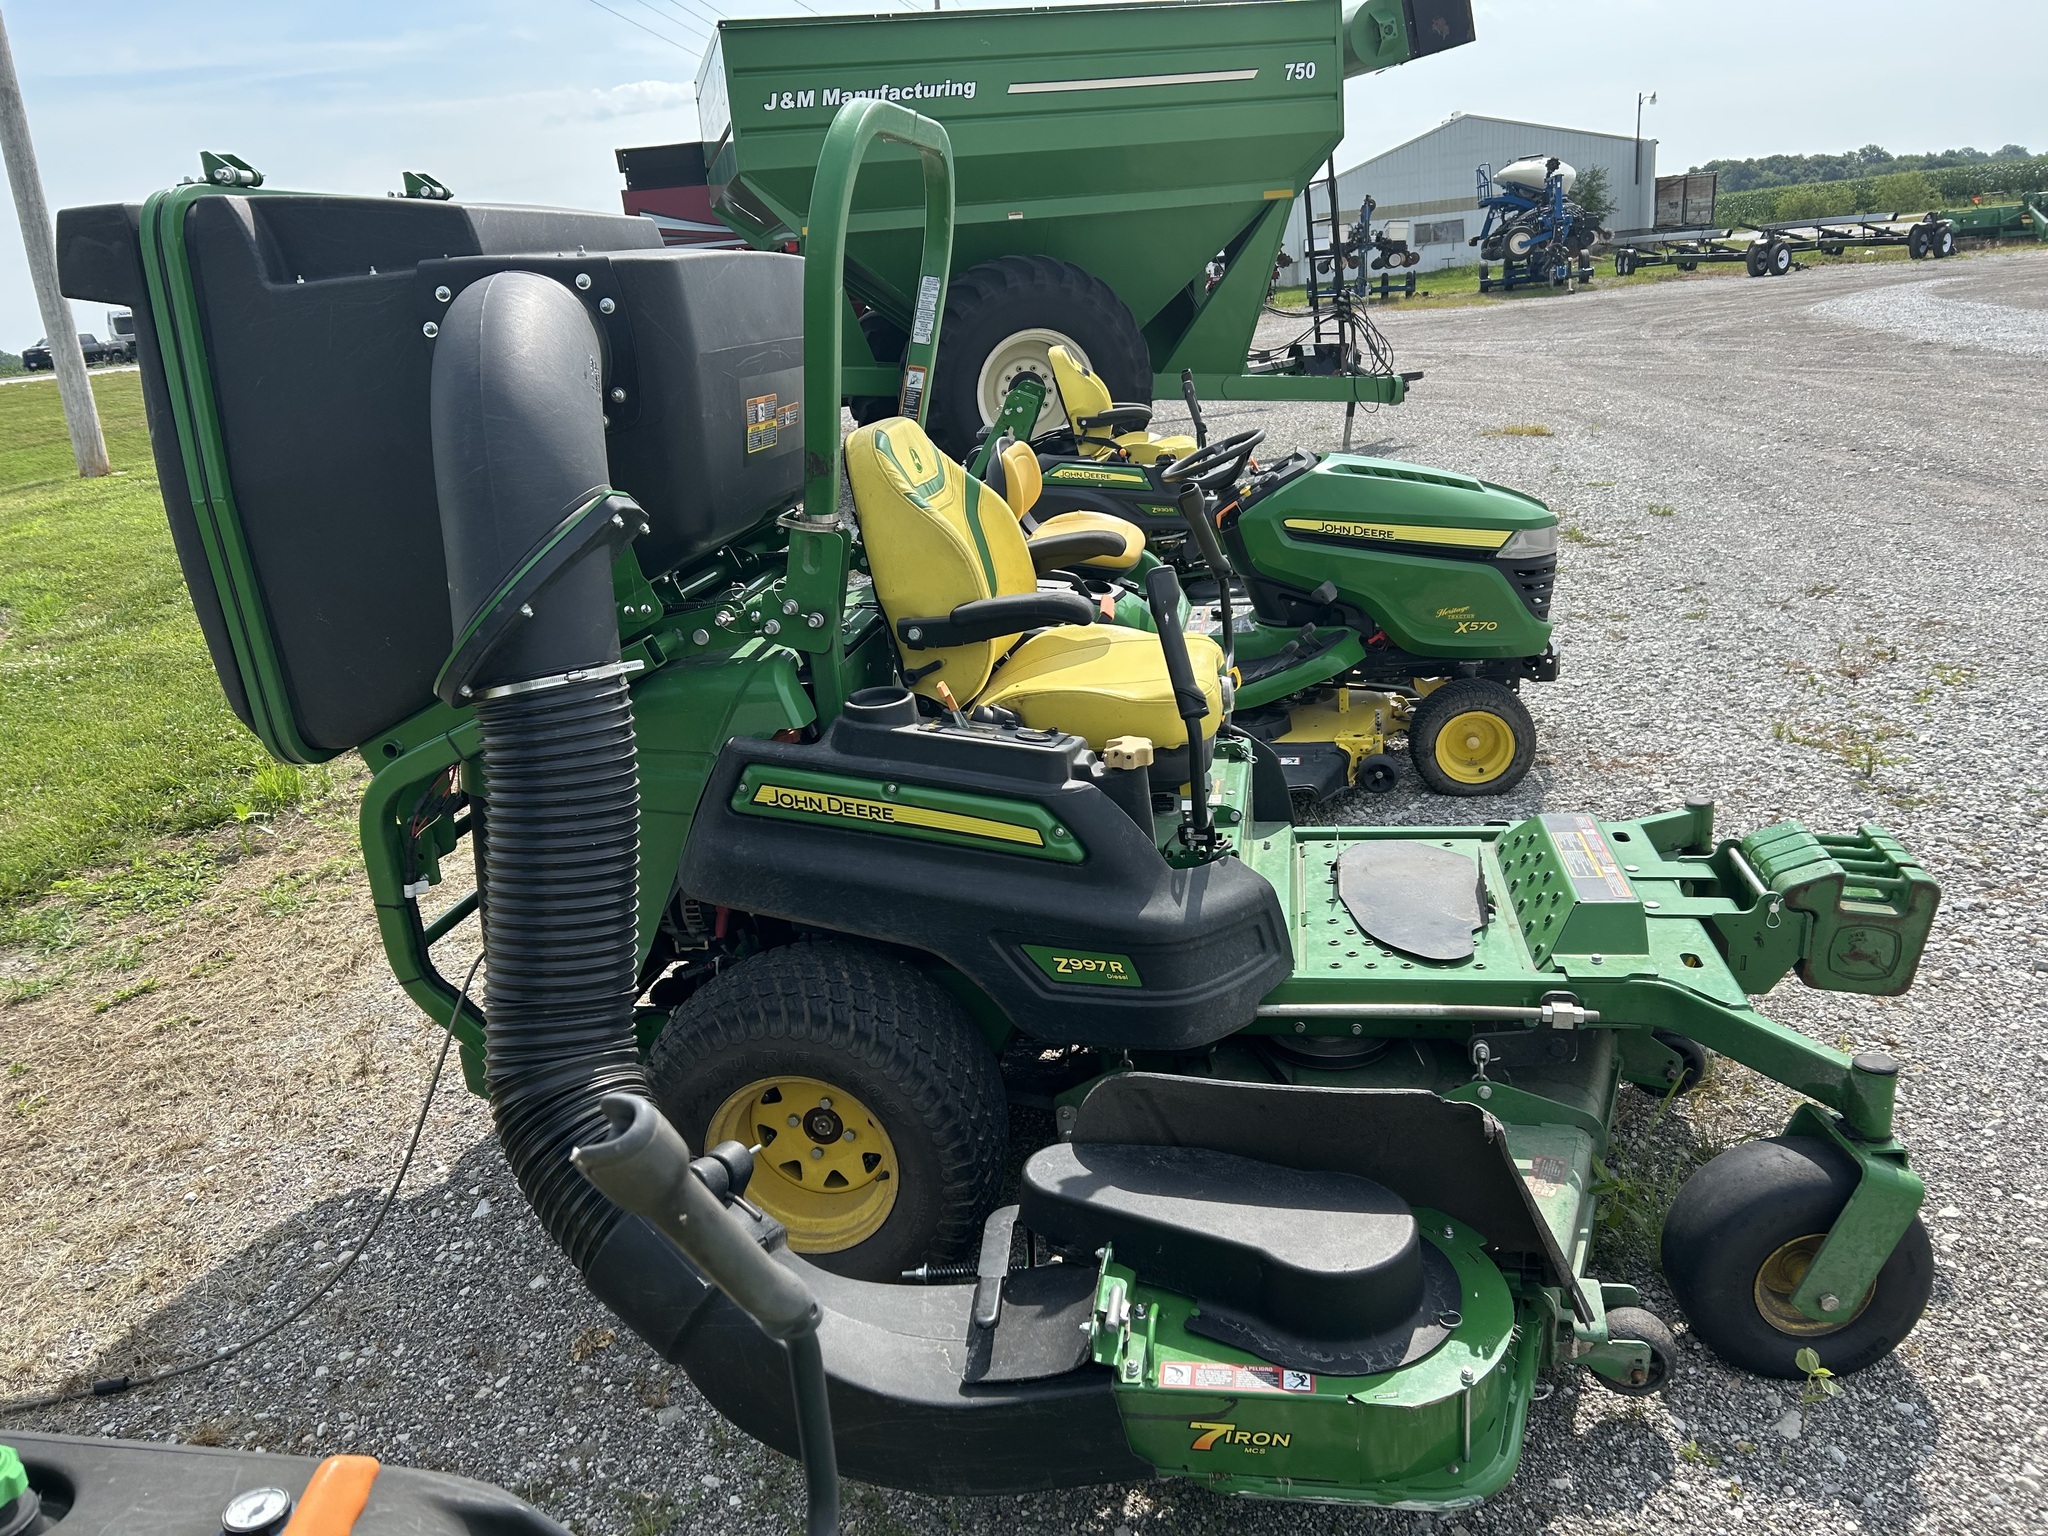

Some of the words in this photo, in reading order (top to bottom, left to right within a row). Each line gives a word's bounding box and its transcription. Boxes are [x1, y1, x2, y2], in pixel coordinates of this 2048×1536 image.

[1284, 61, 1316, 81] 750
[763, 89, 816, 111] J&M
[822, 79, 977, 107] Manufacturing
[1059, 470, 1083, 479] JOHN
[1084, 471, 1112, 480] DEERE
[1318, 522, 1351, 534] JOHN
[1354, 525, 1395, 539] DEERE
[1435, 605, 1470, 618] Heritage
[1454, 621, 1498, 634] X570
[769, 789, 823, 811] JOHN
[827, 797, 895, 821] DEERE
[1052, 956, 1125, 974] Z997R
[1106, 973, 1129, 981] Diesel
[1248, 1365, 1274, 1373] PELIGRO
[1243, 1447, 1267, 1455] MCS
